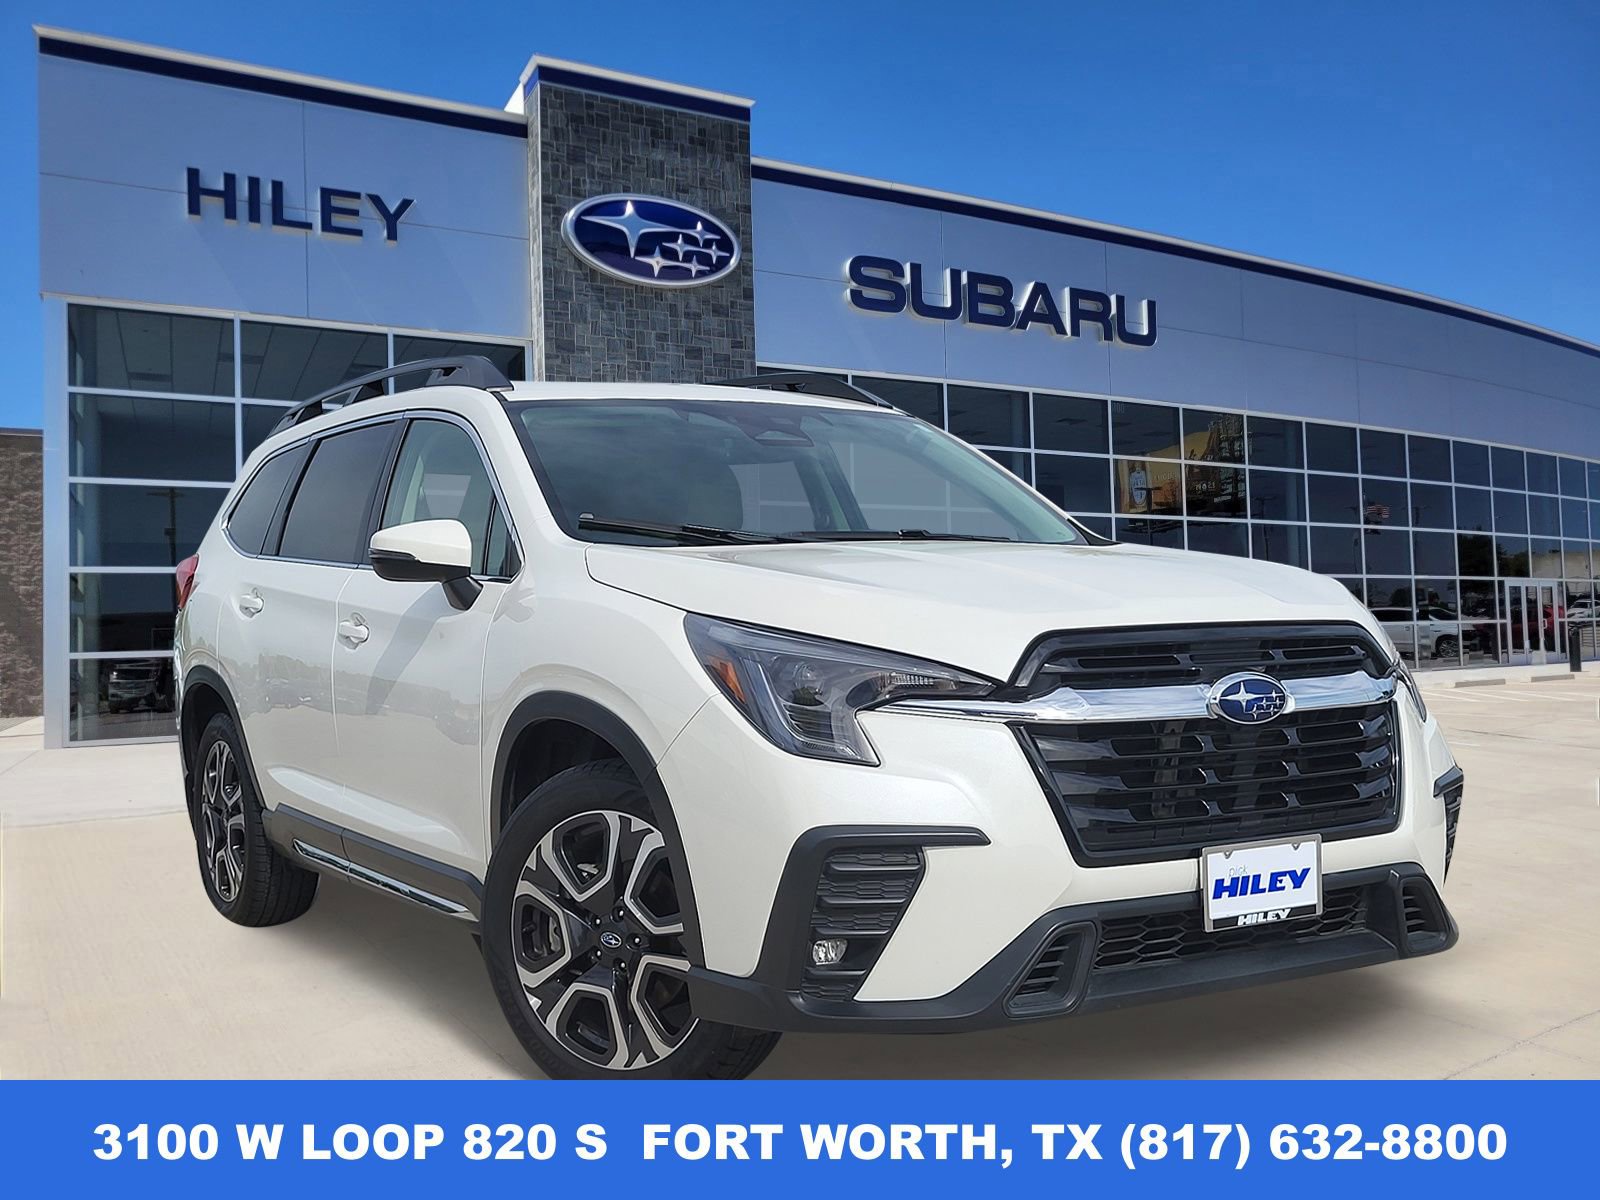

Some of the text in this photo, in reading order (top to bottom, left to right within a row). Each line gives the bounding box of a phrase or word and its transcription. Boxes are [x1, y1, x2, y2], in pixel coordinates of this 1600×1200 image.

[186, 166, 416, 241] HILEY
[847, 254, 1158, 347] SUBARU
[1212, 867, 1311, 900] HILEY
[1237, 908, 1291, 926] HILEY
